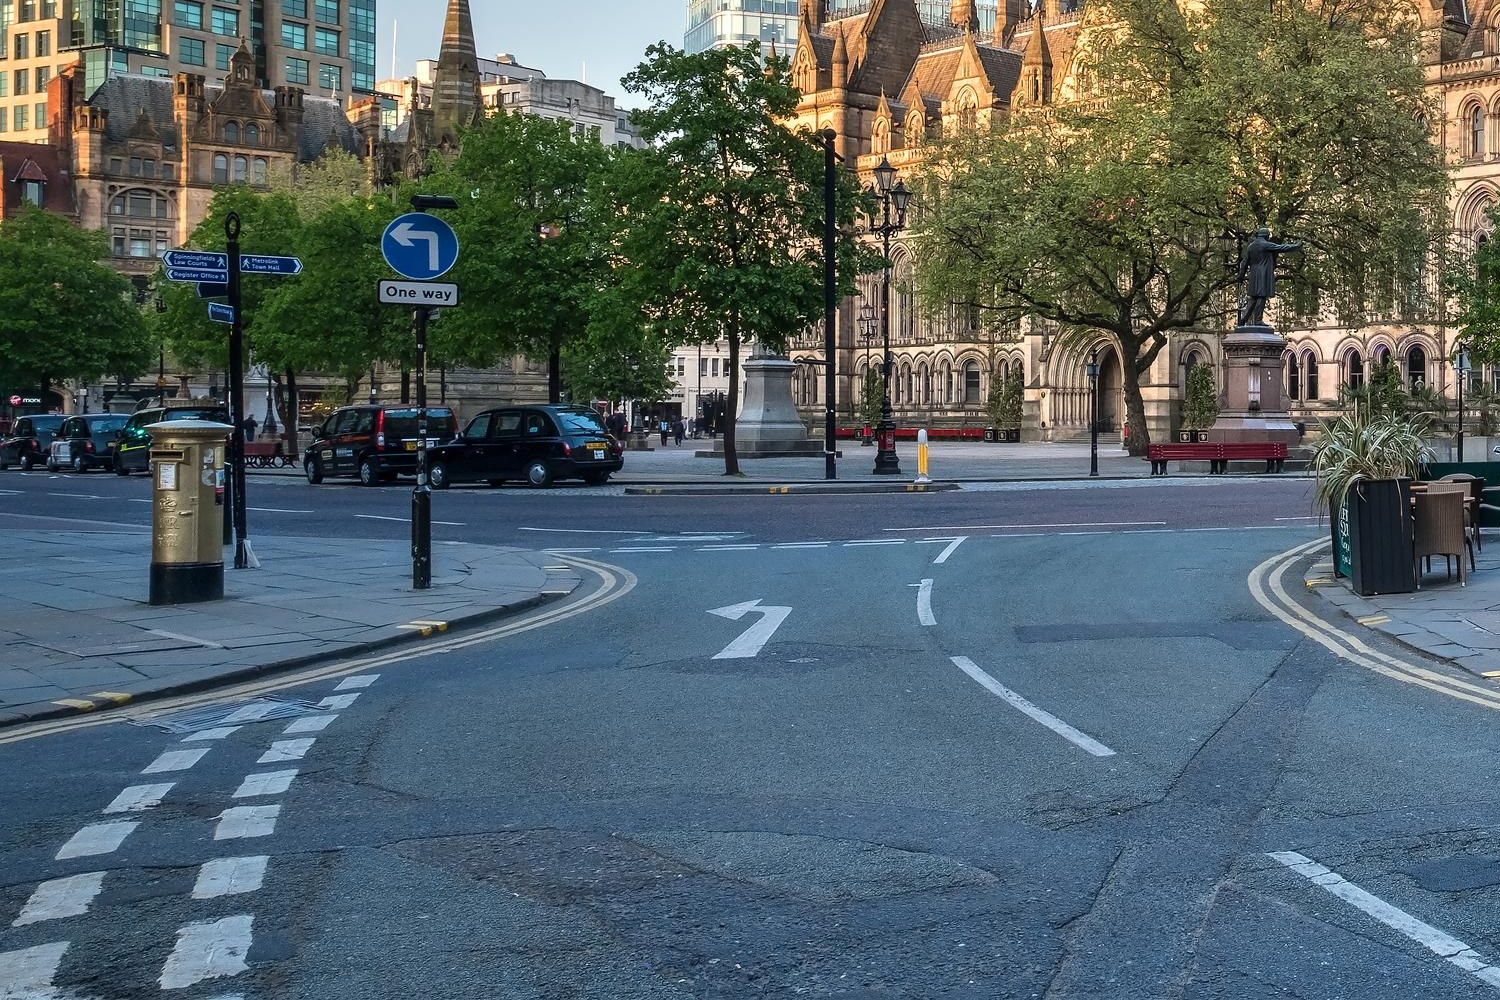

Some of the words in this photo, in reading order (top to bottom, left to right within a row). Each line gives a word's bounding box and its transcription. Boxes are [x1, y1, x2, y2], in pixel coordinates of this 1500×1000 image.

[173, 253, 216, 262] Spinningfields
[173, 271, 198, 279] Register
[200, 272, 219, 280] Office
[386, 286, 417, 298] One
[422, 289, 452, 302] way
